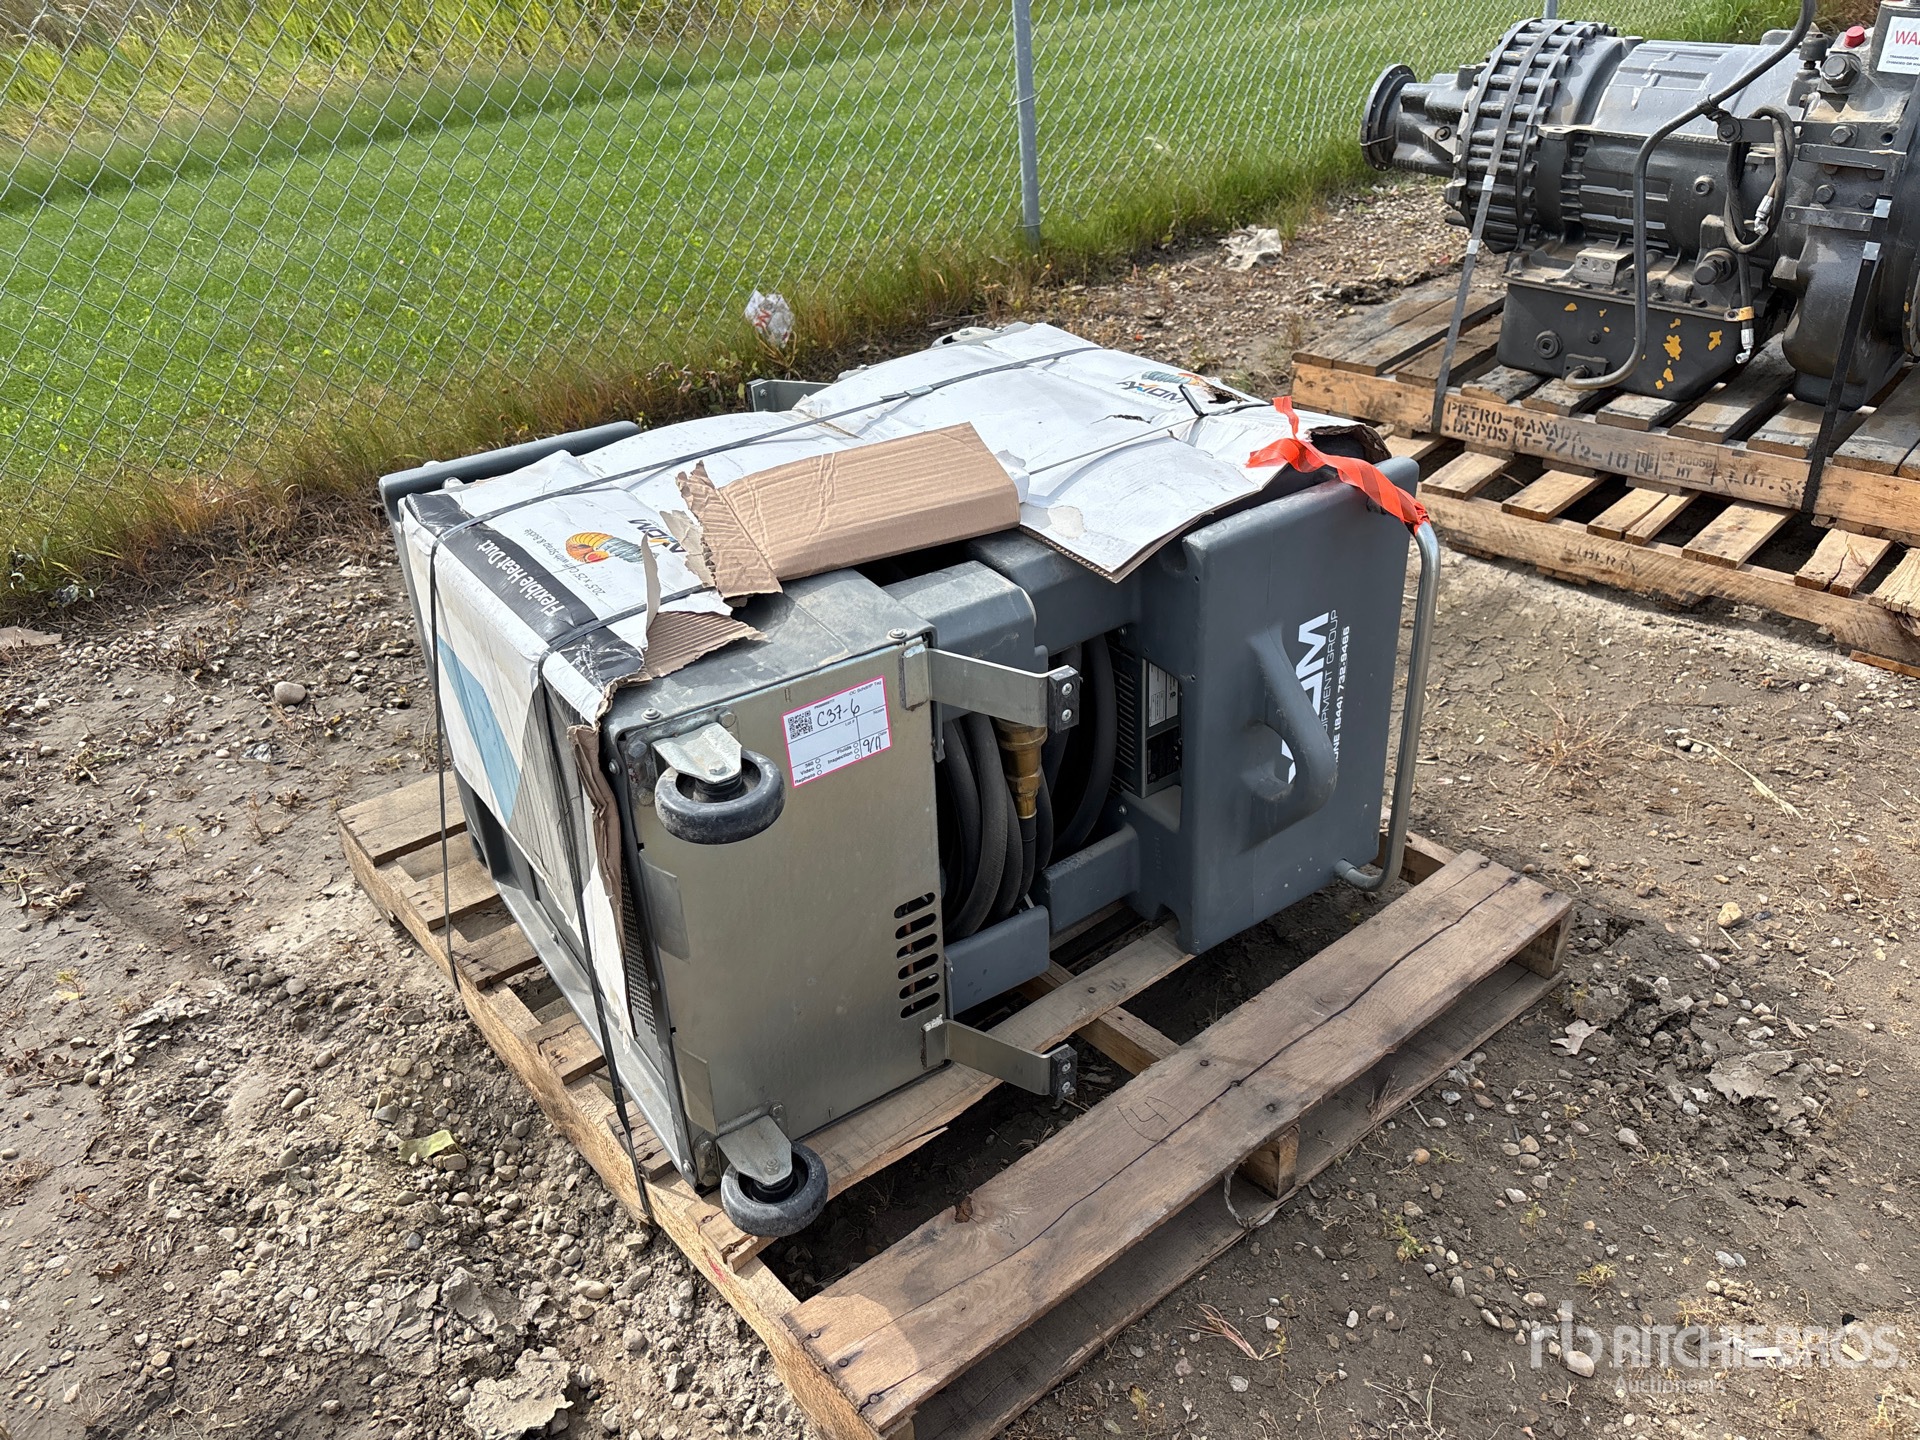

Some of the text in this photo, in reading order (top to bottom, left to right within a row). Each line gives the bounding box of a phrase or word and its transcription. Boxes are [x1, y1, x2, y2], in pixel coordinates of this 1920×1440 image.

[1115, 381, 1186, 403] AXIOM
[1676, 467, 1692, 478] HT
[543, 542, 560, 556] Strap
[476, 539, 565, 617] Flexible Heat Duct
[1326, 610, 1339, 665] GROUP
[816, 698, 861, 727] C37-6
[837, 745, 852, 754] Fluids
[828, 750, 853, 764] Inspection
[800, 767, 815, 776] Video
